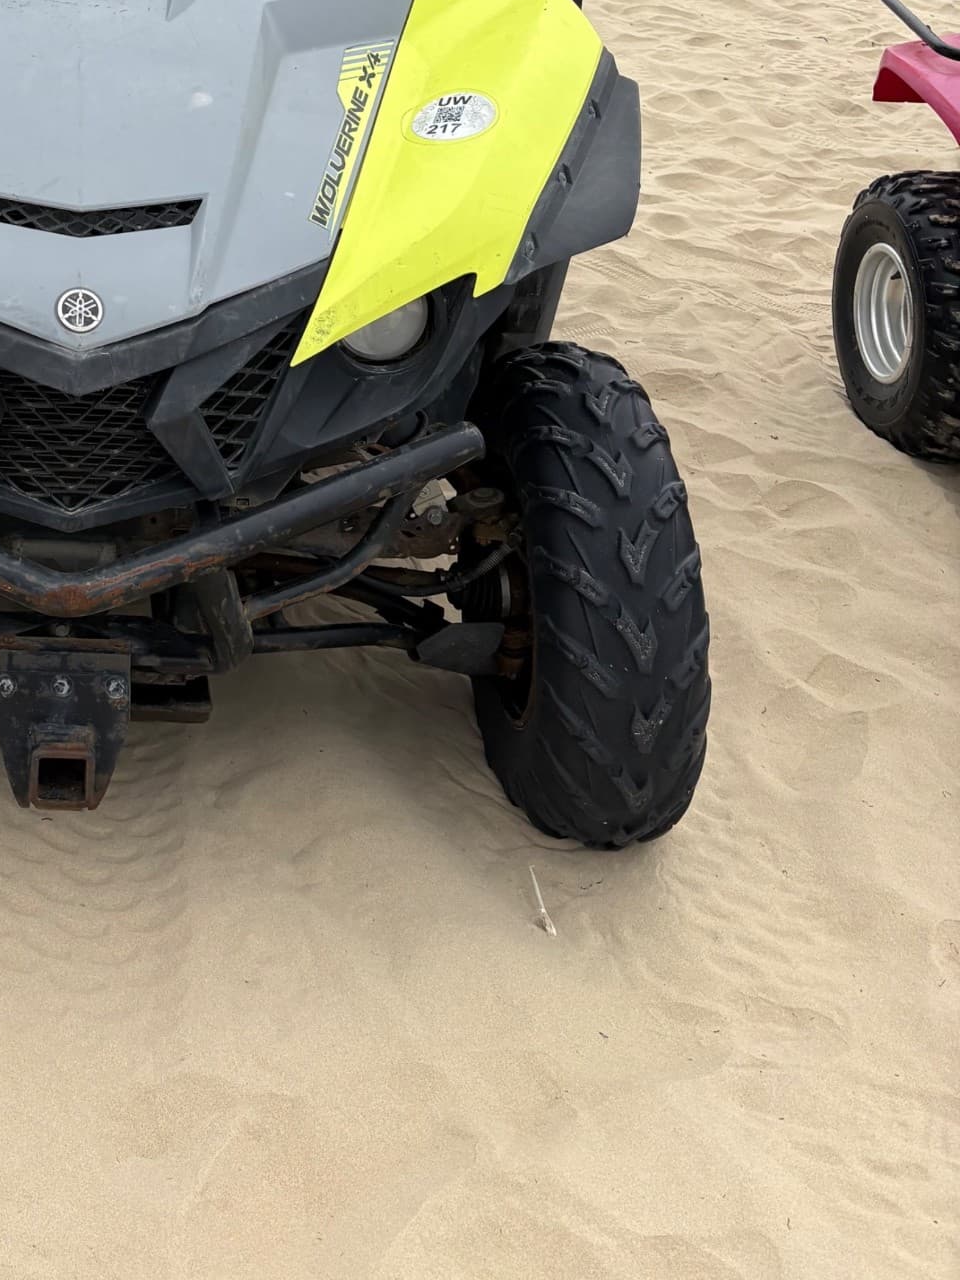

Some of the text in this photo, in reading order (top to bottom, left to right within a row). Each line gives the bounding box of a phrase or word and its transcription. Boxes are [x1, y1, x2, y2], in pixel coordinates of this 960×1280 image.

[438, 95, 473, 107] UW
[426, 123, 462, 135] 217
[311, 86, 368, 227] WOLVERINE
